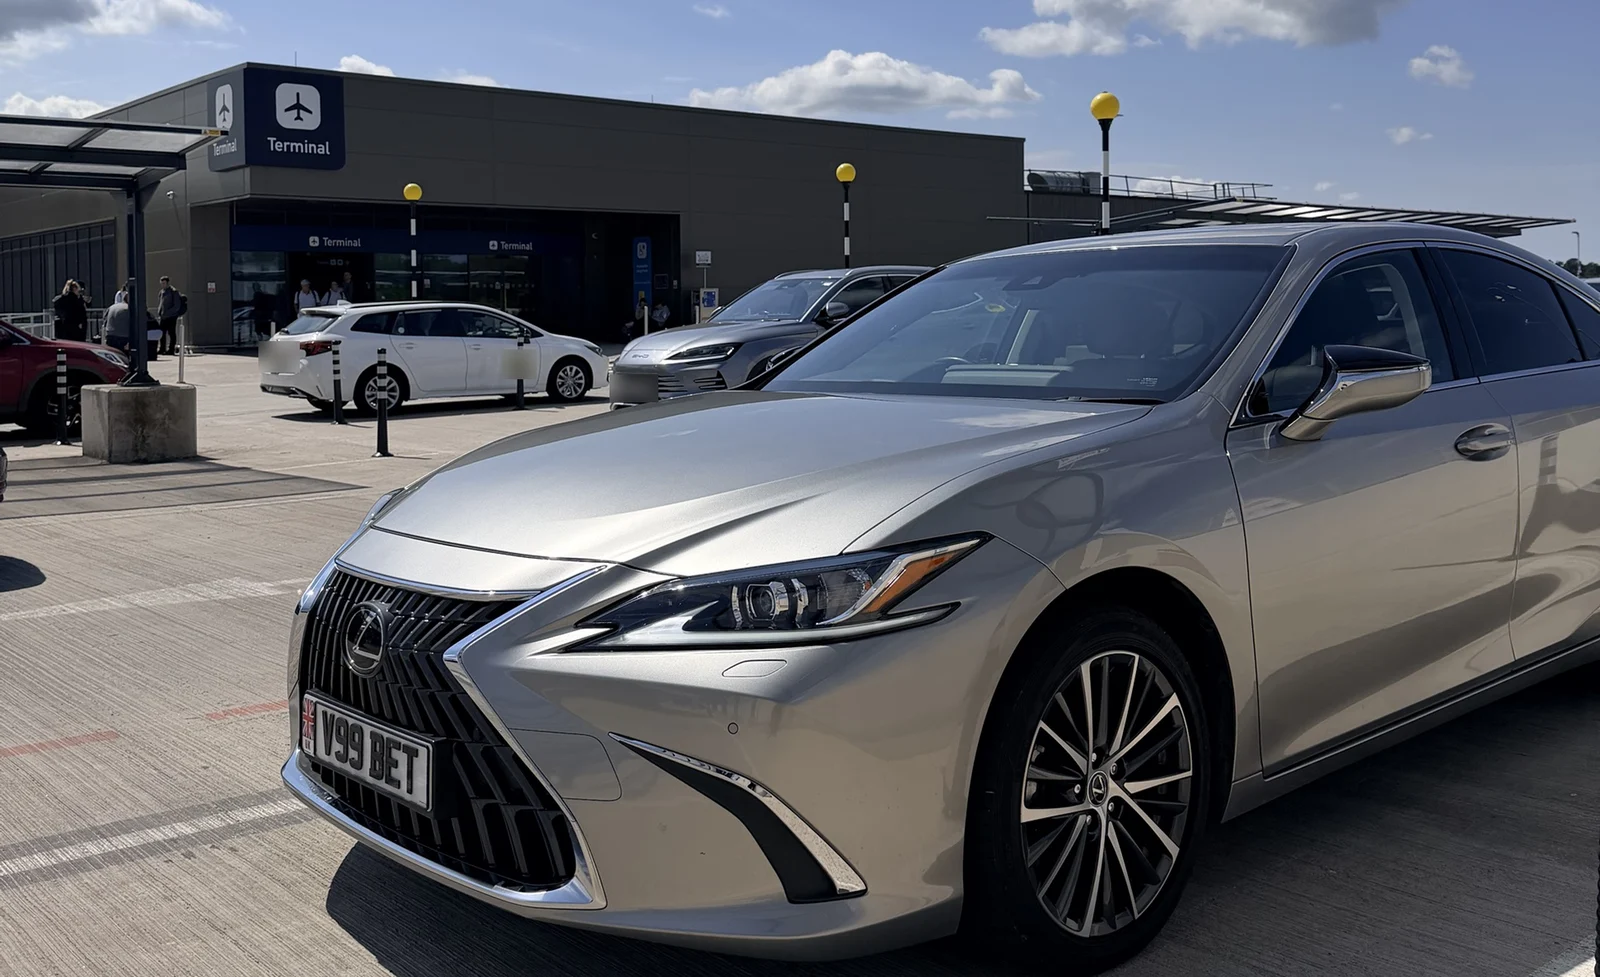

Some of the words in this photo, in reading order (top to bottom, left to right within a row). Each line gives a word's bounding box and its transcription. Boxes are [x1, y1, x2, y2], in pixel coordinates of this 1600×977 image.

[213, 138, 237, 156] Terminal
[267, 137, 330, 155] Terminal
[322, 237, 361, 247] Terminal
[500, 240, 533, 251] Terminal
[321, 710, 364, 771] V99
[368, 730, 419, 795] BET
